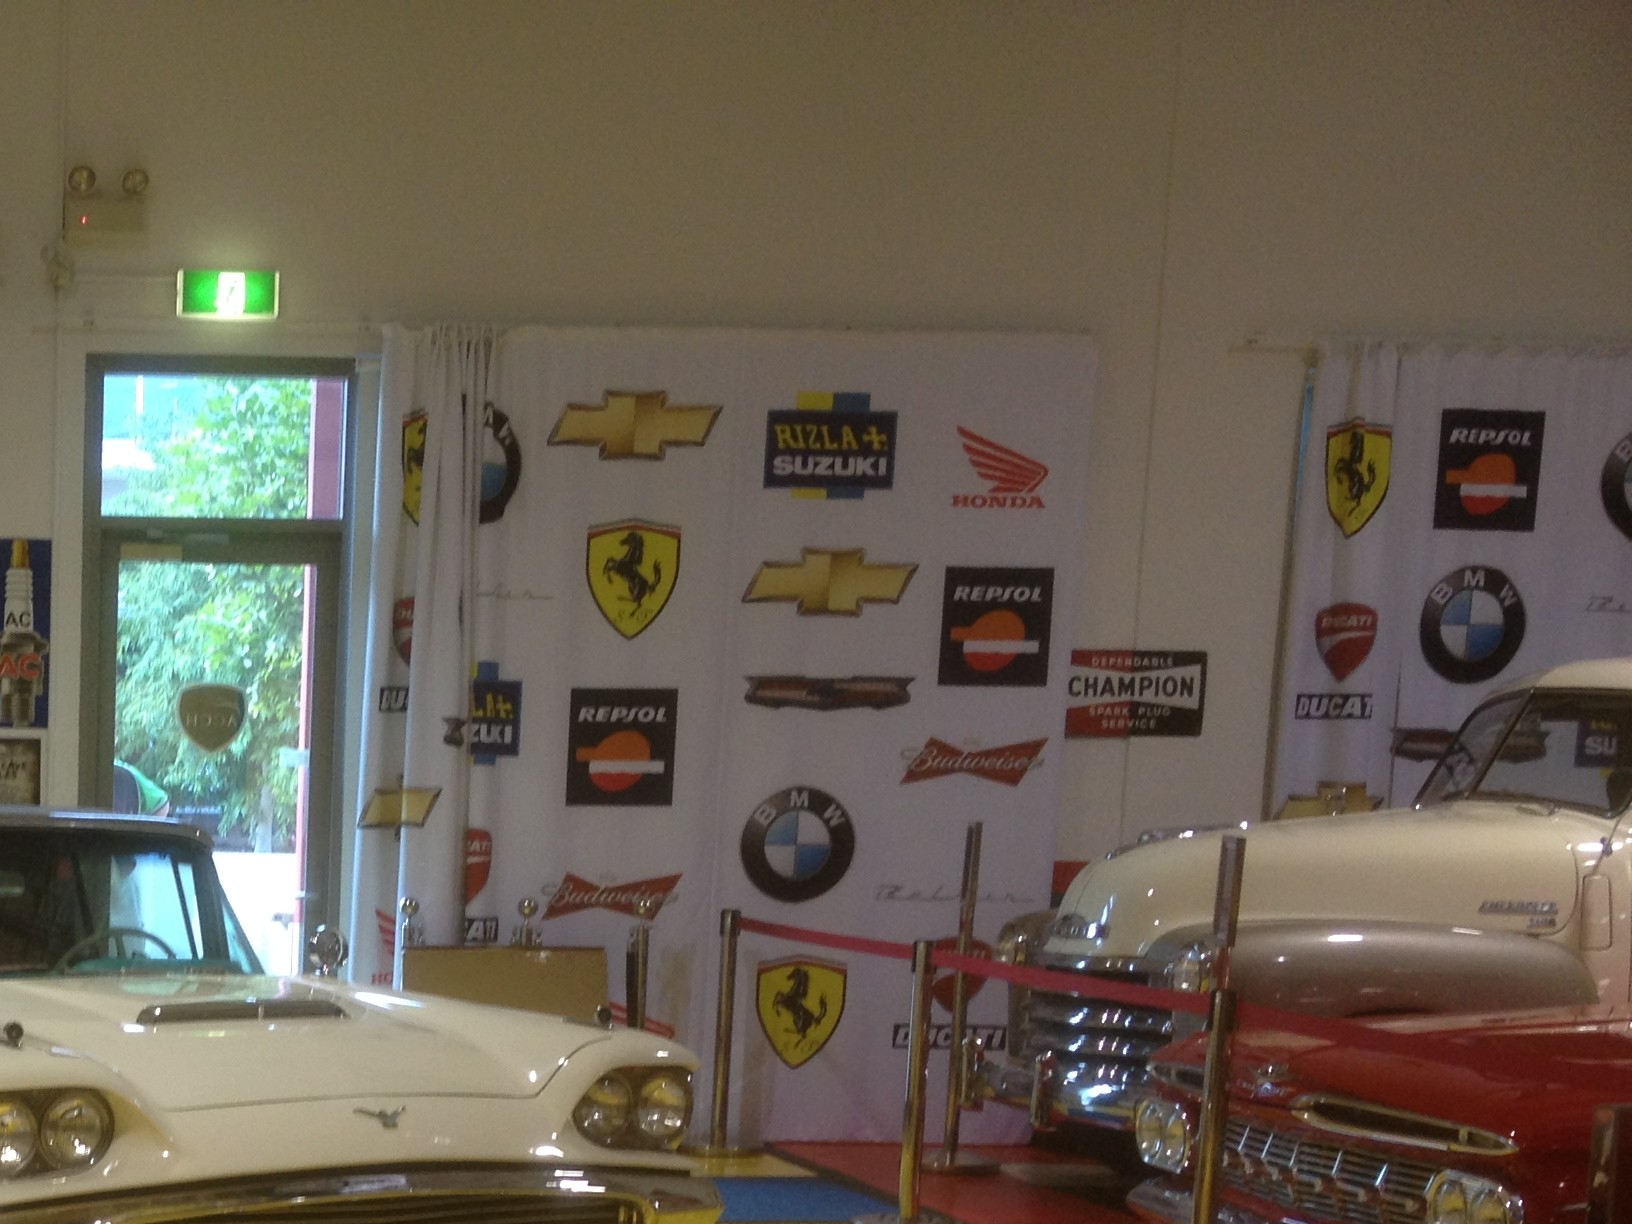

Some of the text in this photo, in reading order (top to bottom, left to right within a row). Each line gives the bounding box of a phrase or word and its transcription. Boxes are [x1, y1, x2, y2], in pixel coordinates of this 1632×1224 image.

[1449, 428, 1532, 445] REPSOL
[773, 455, 887, 476] SUZUKI
[951, 494, 1045, 509] HONDA
[953, 586, 1042, 602] REPSOL
[1430, 569, 1517, 607] BMW
[5, 611, 31, 628] AC
[1091, 656, 1173, 667] DEPENDABLE
[1068, 675, 1195, 698] CHAMPION
[578, 705, 667, 722] REPSOL
[1088, 705, 1171, 717] SPARK PLUG
[1101, 719, 1157, 730] SERVICE
[902, 747, 1045, 772] Budweiser
[753, 789, 846, 827] BMW
